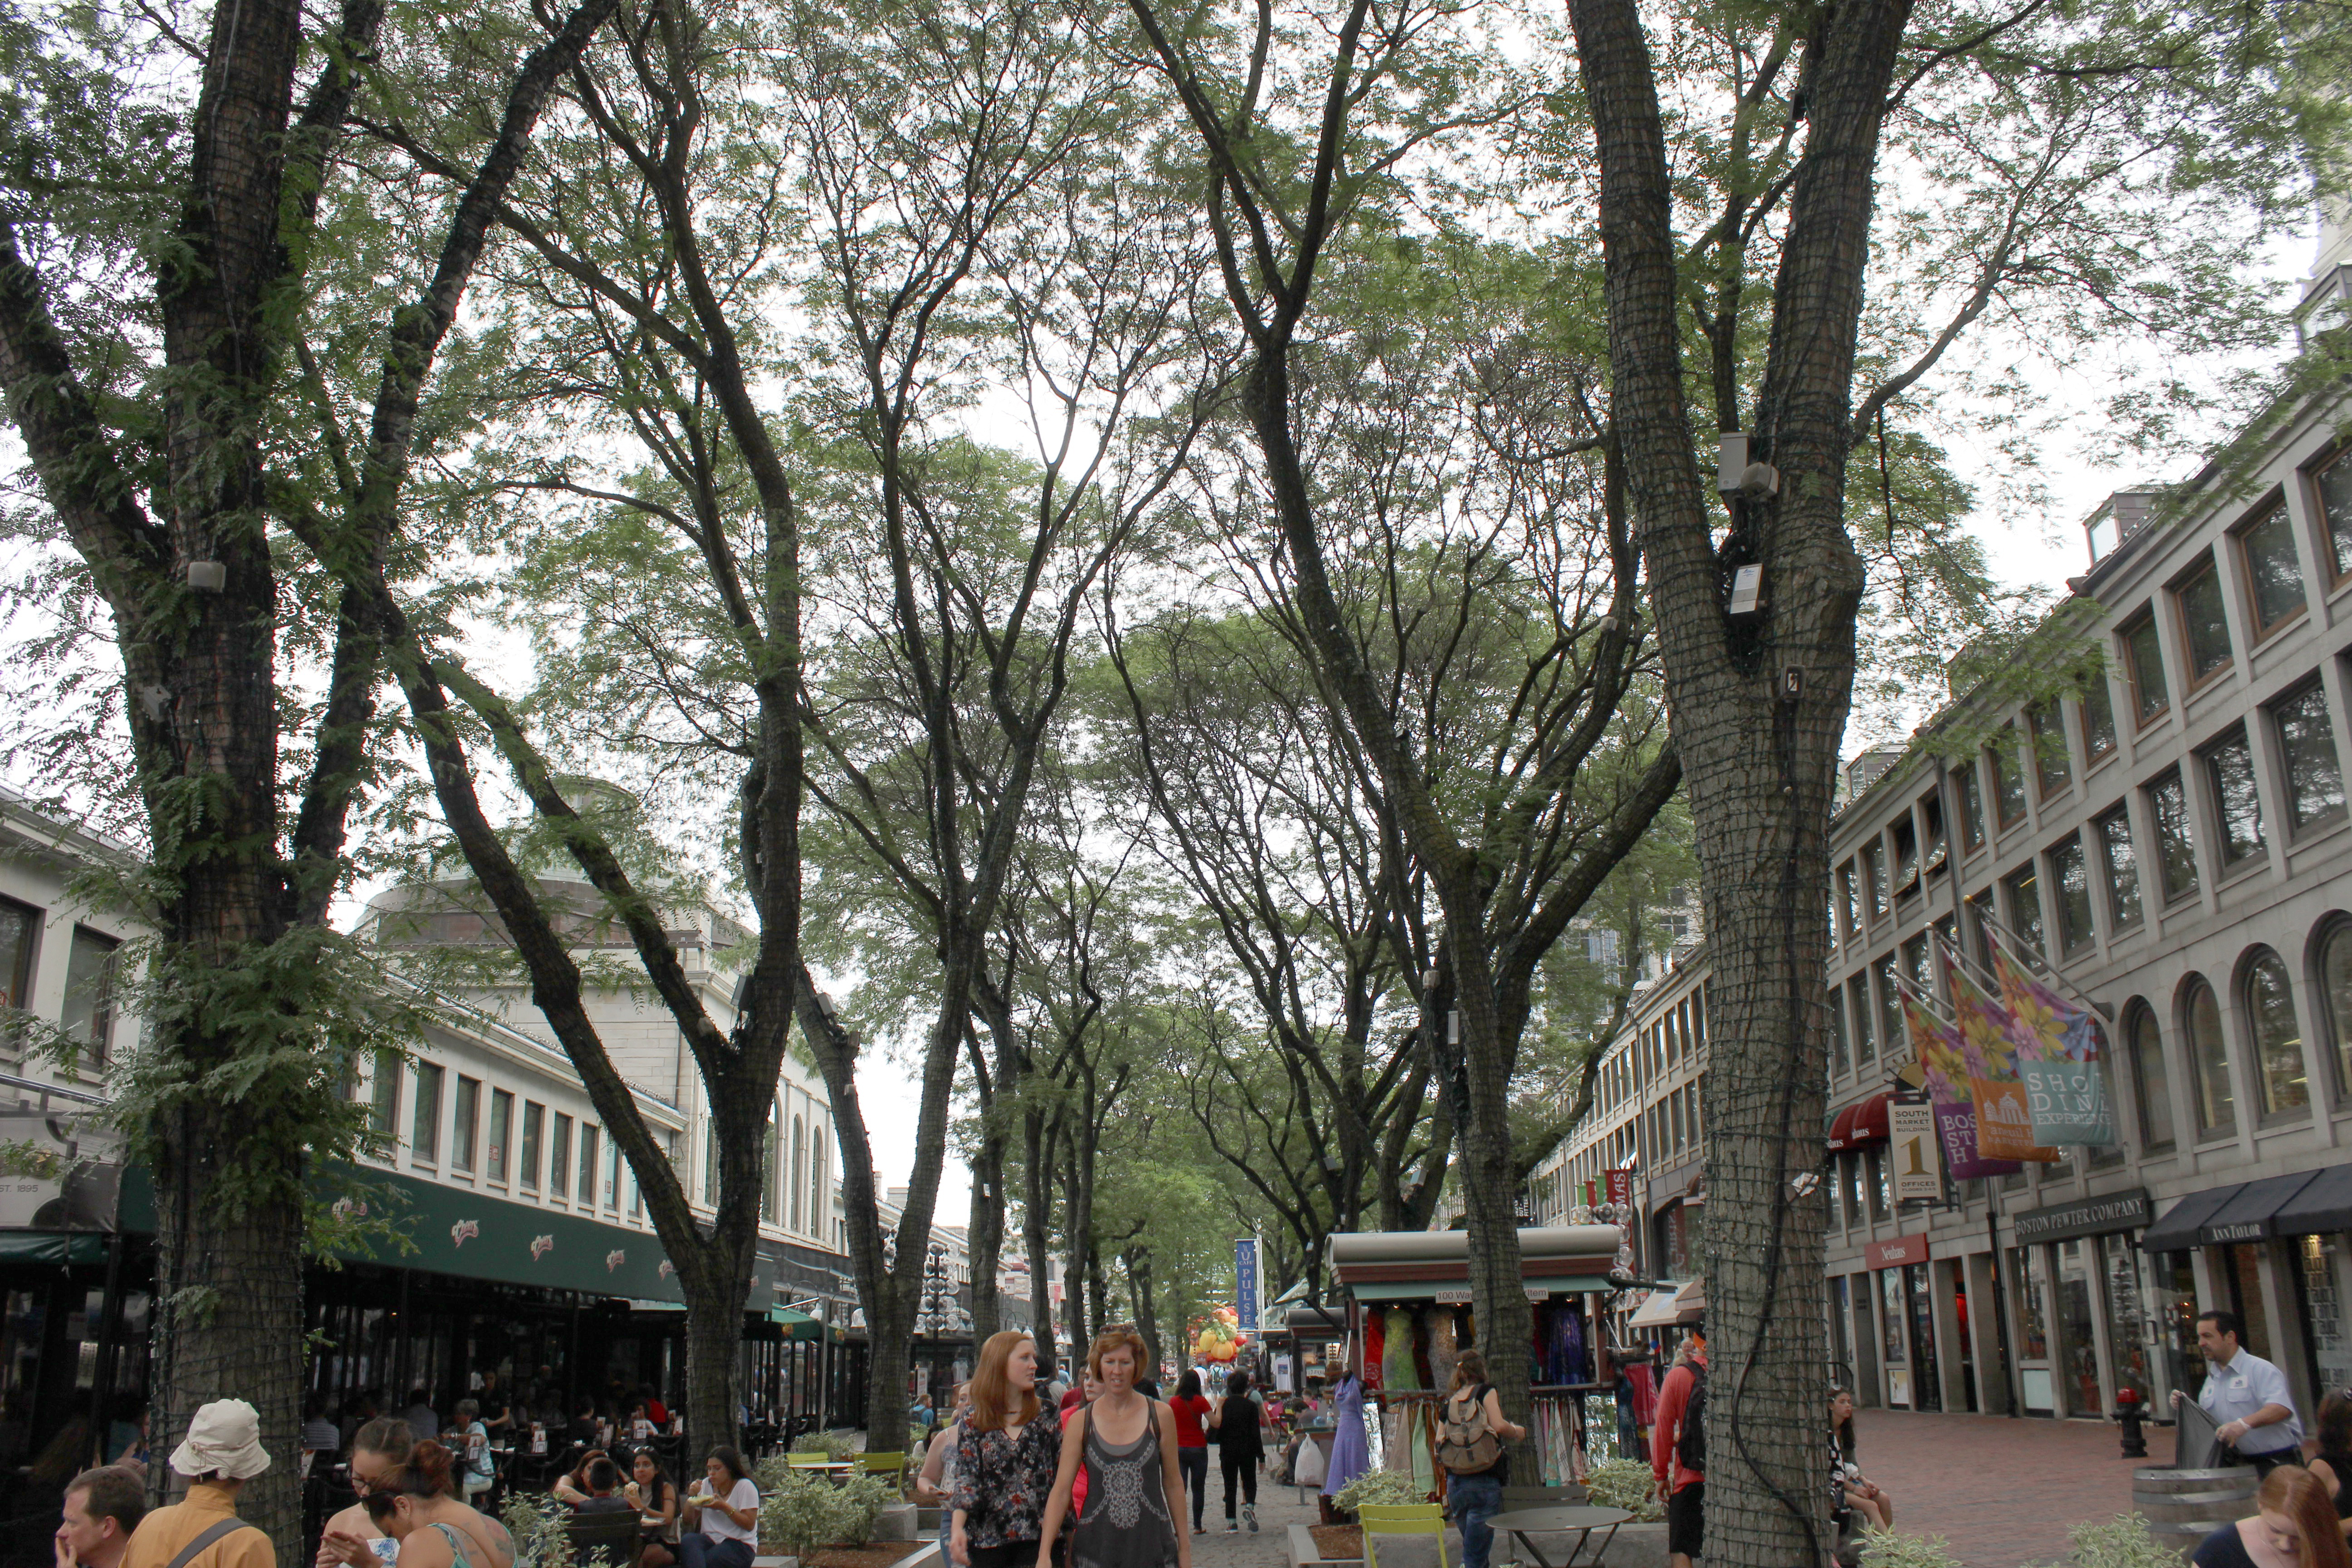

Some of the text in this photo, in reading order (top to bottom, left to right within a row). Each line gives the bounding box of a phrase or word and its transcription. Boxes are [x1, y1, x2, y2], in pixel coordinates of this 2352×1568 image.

[1900, 1135, 1933, 1176] 1
[2015, 1197, 2143, 1235] BOSTON PEWTER COMPANY
[1881, 1245, 1906, 1261] Neuhaus
[1242, 1269, 1251, 1323] PULSE
[1437, 1292, 1453, 1300] 100
